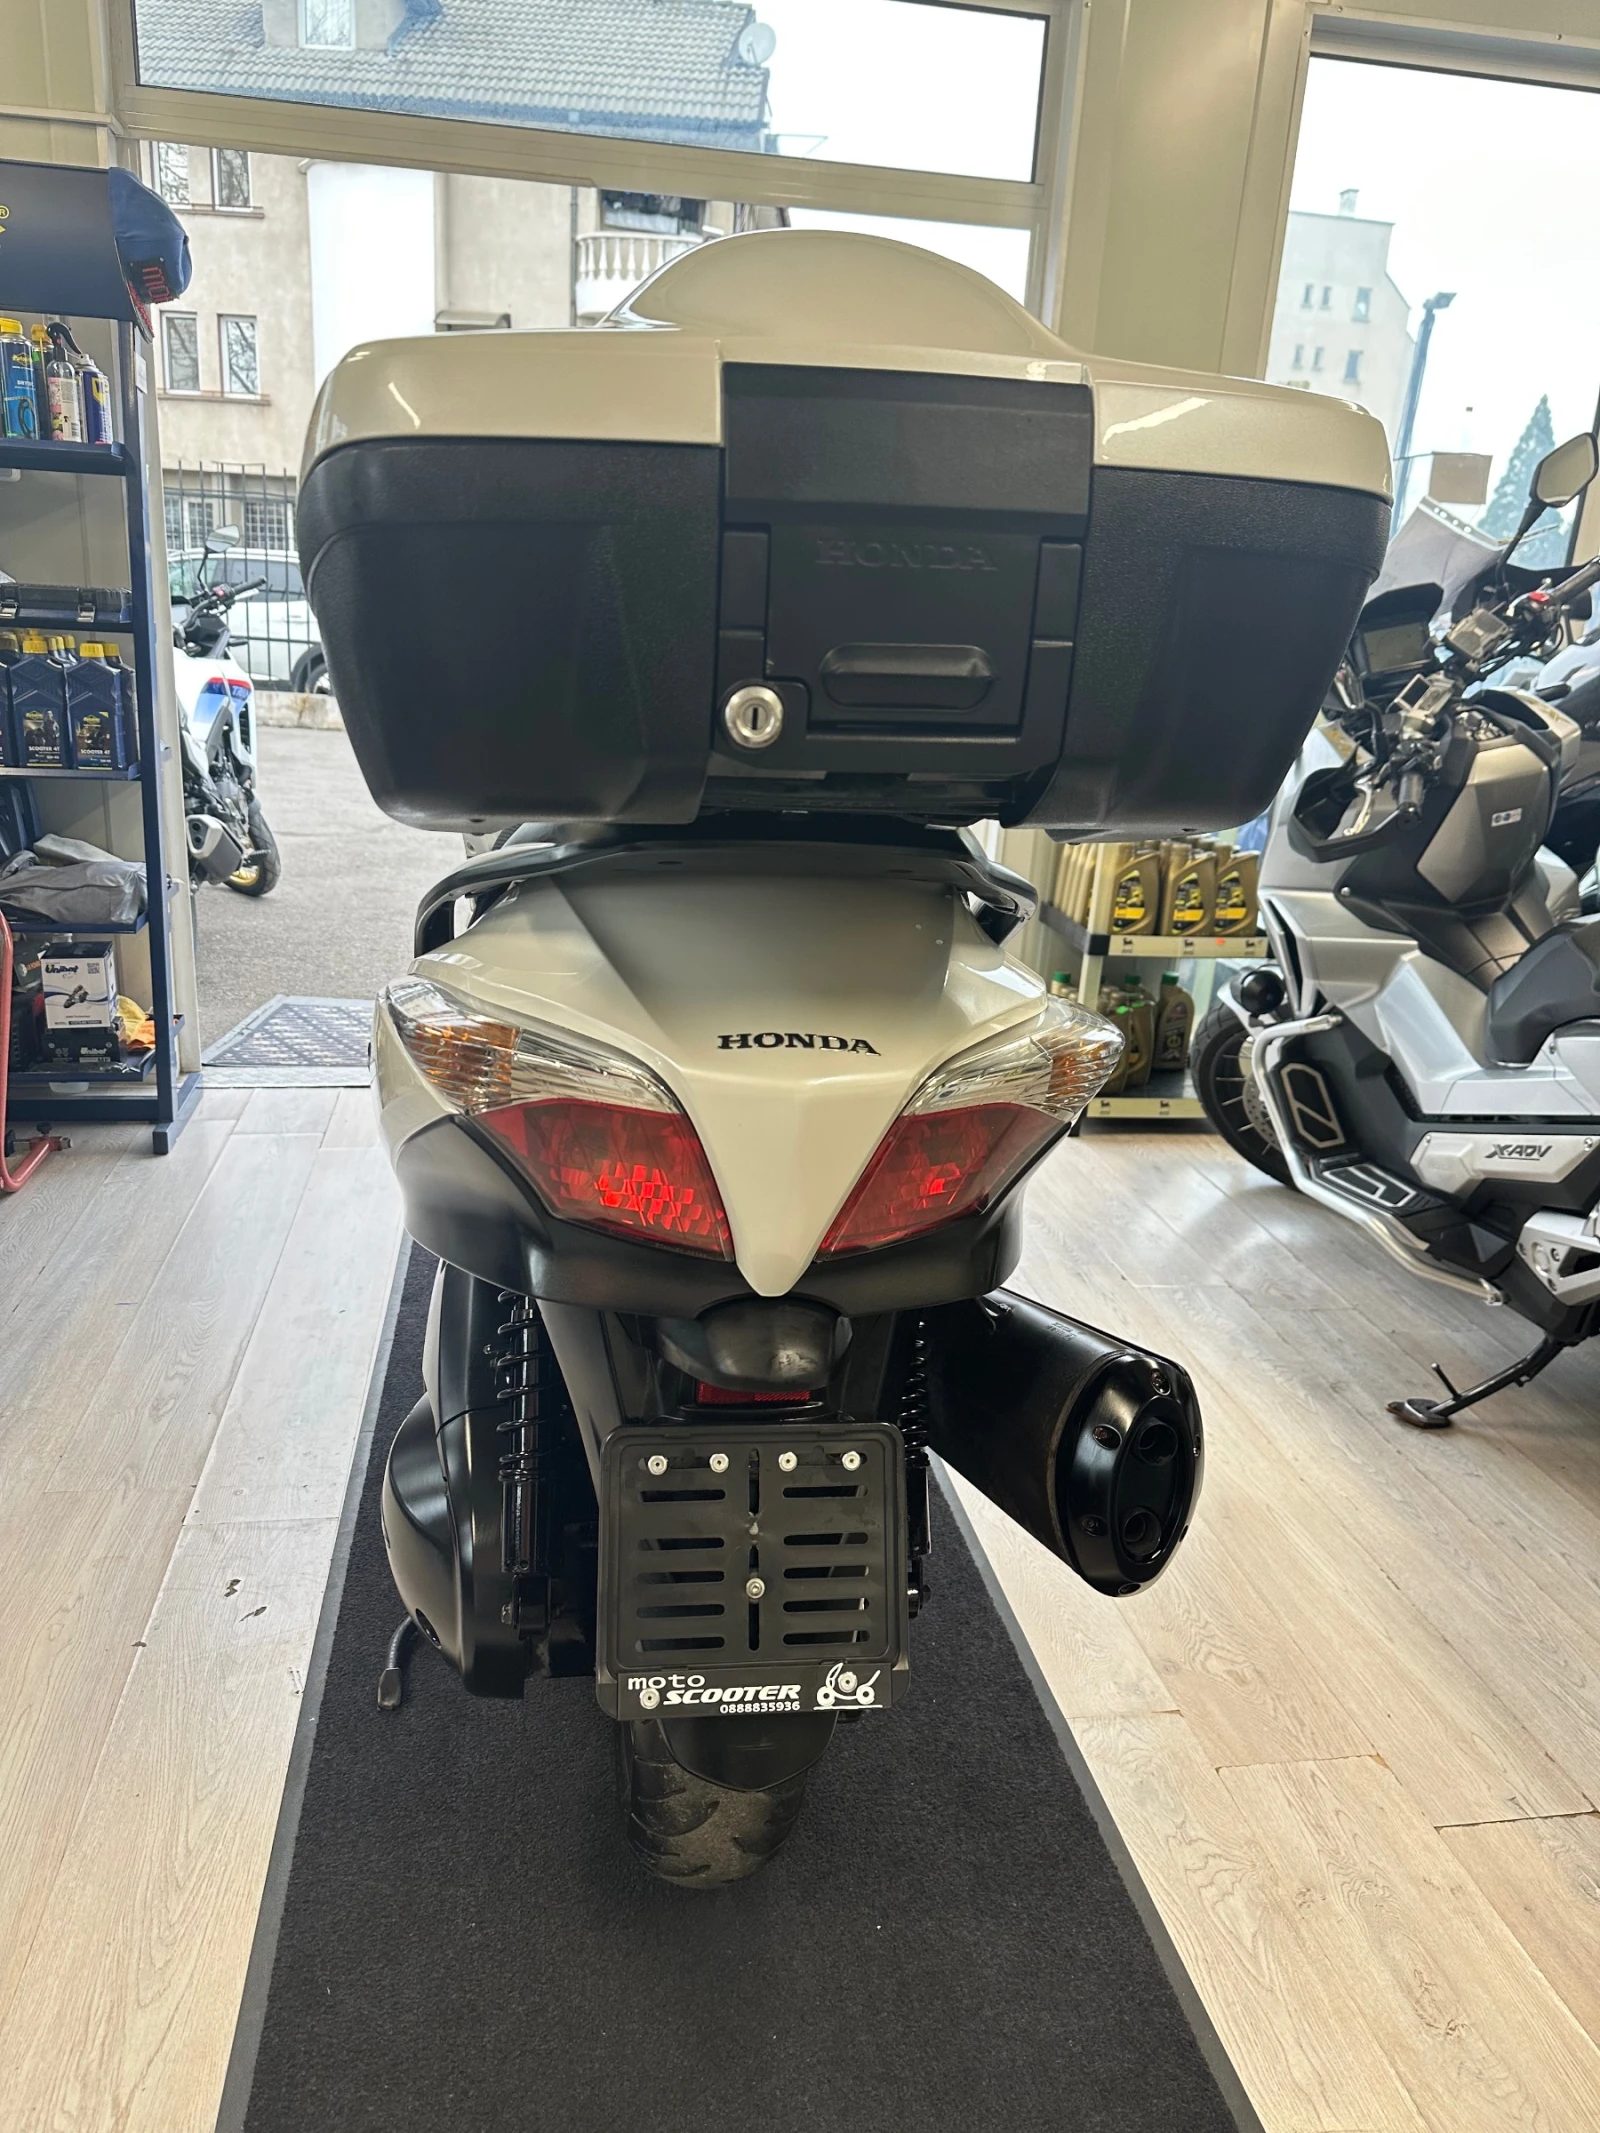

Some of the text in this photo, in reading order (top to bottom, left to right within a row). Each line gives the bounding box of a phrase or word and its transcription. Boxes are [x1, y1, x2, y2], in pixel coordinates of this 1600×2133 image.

[815, 541, 998, 571] HONDA
[717, 1032, 881, 1056] HONDA
[1484, 1144, 1553, 1160] X-ADV
[628, 1674, 706, 1690] moto
[663, 1684, 801, 1705] SCOOTER
[720, 1701, 800, 1714] 0888835936
